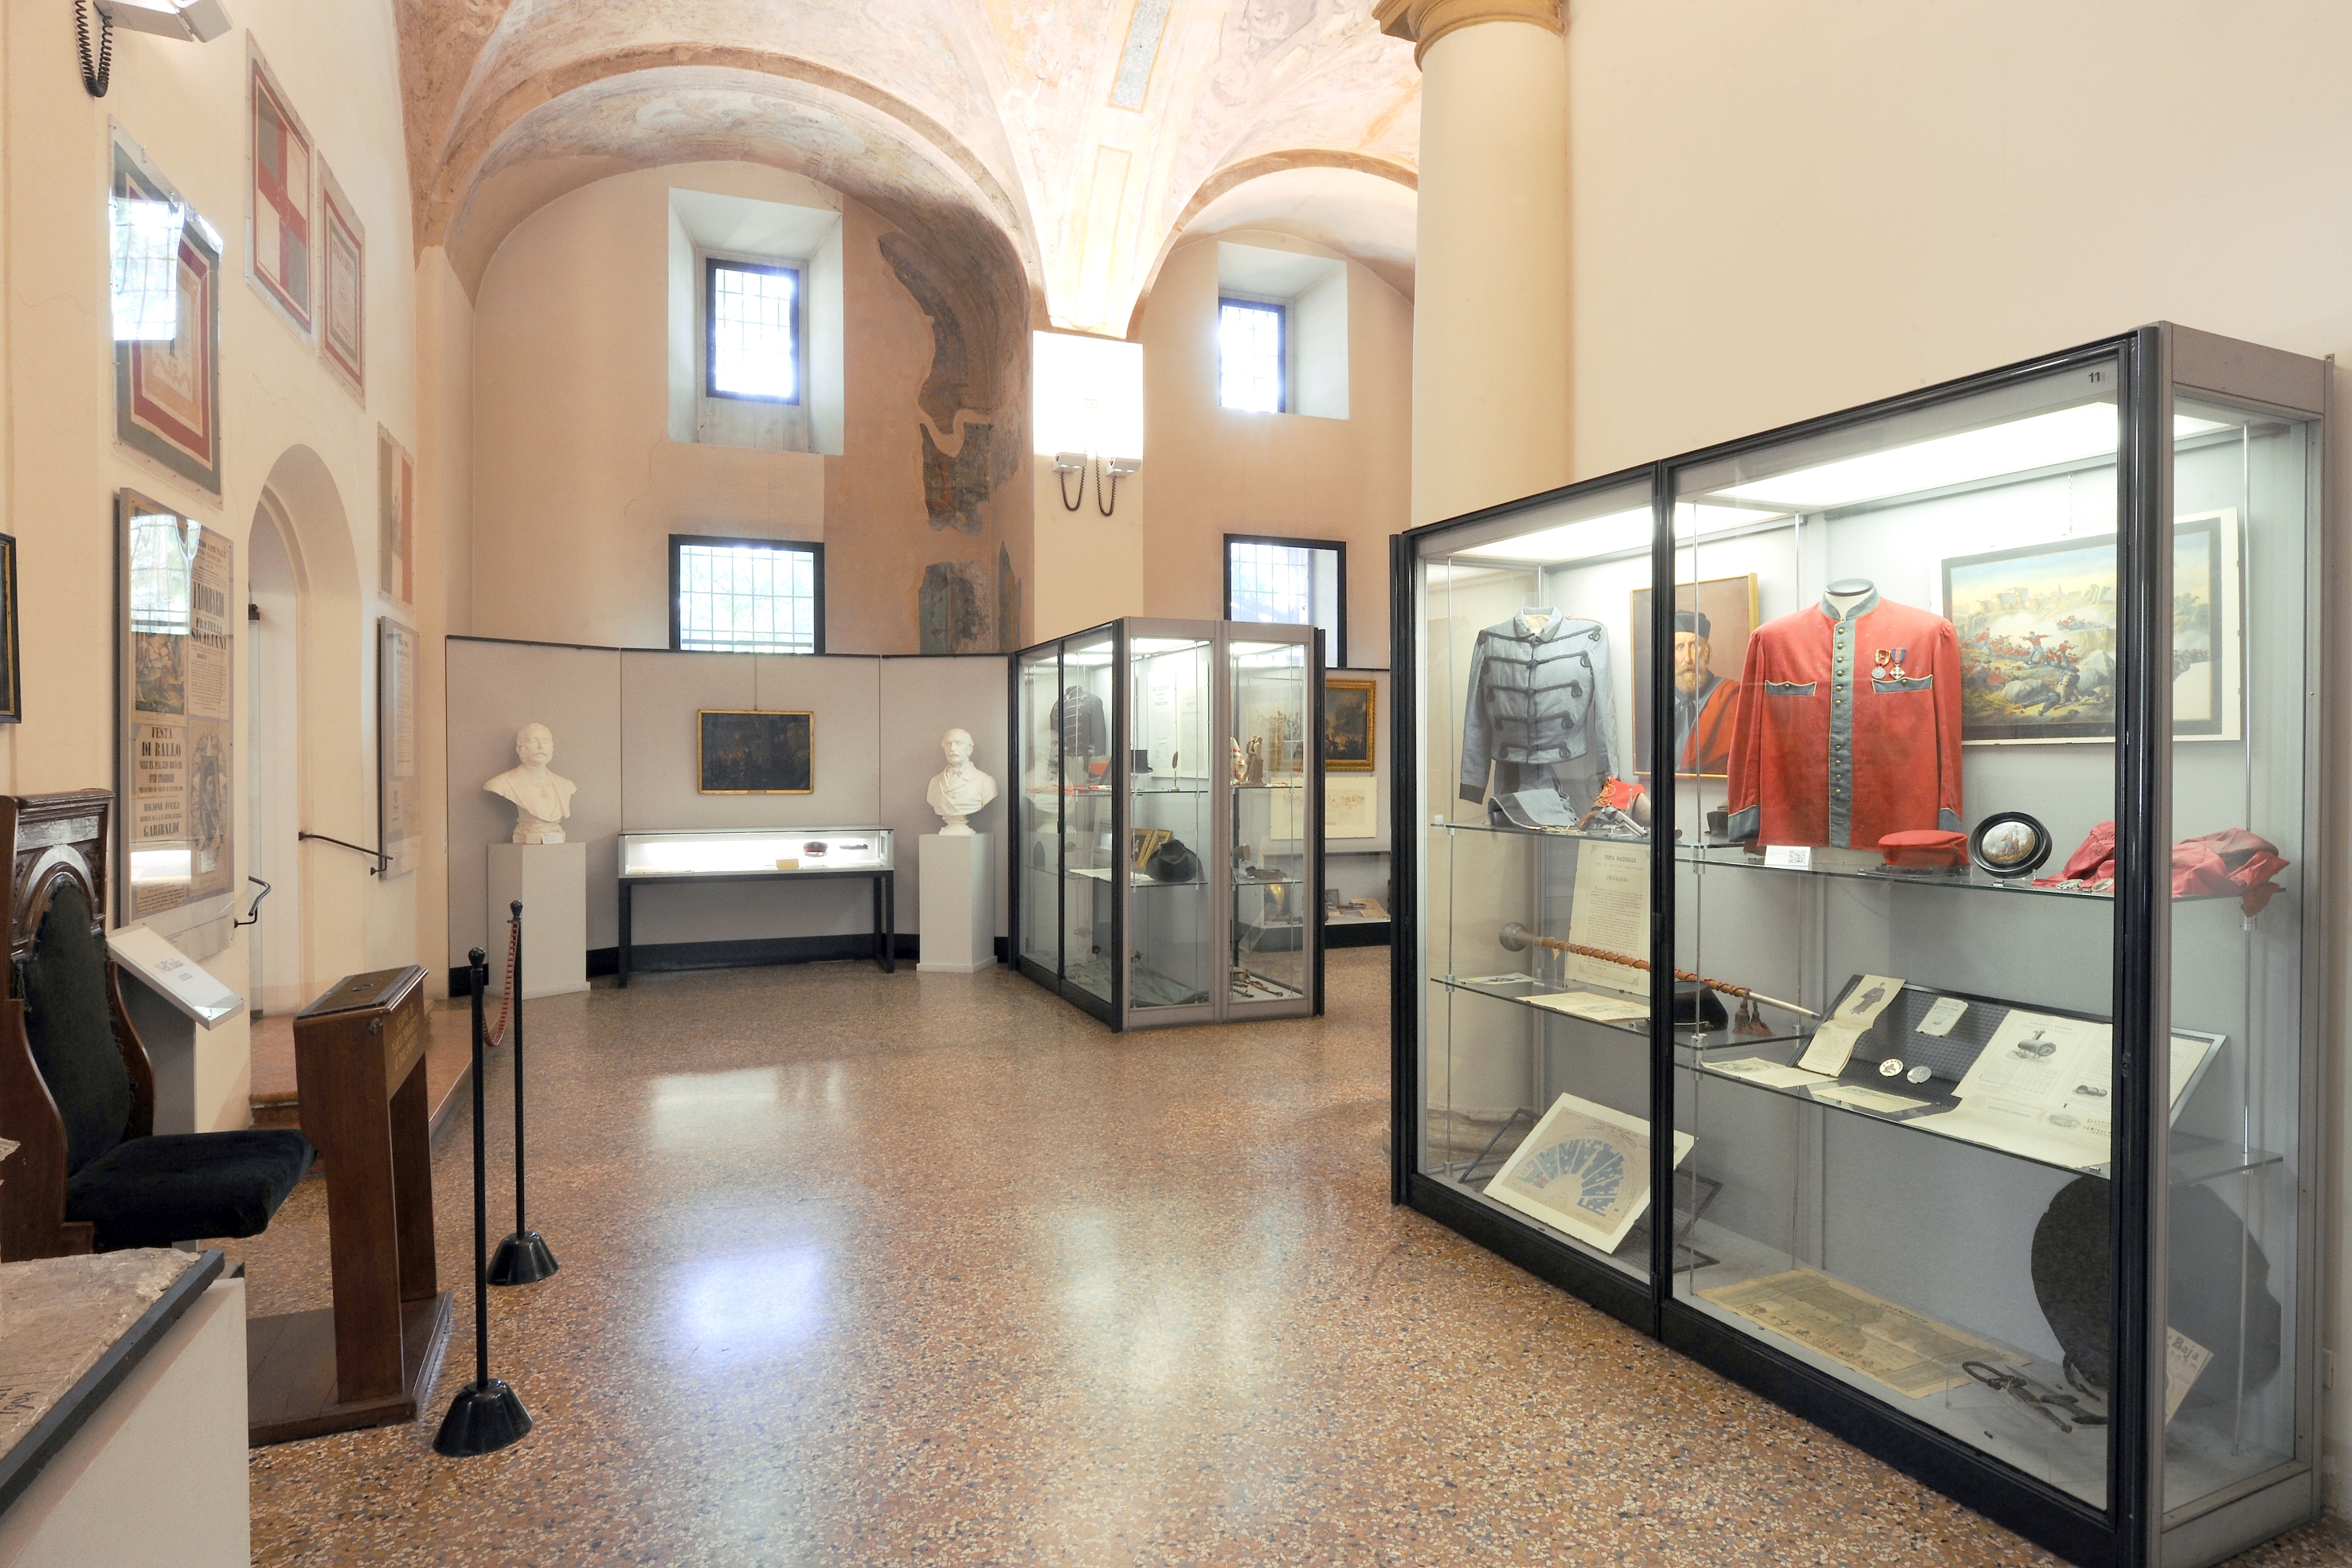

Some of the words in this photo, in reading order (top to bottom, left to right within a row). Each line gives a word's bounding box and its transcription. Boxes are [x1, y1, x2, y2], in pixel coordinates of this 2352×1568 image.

[2088, 371, 2100, 383] 11
[151, 726, 173, 739] FESTA
[142, 741, 151, 757] DI
[155, 742, 182, 757] BALLO
[143, 822, 179, 837] GARIBALDI
[2172, 1335, 2199, 1361] Baja
